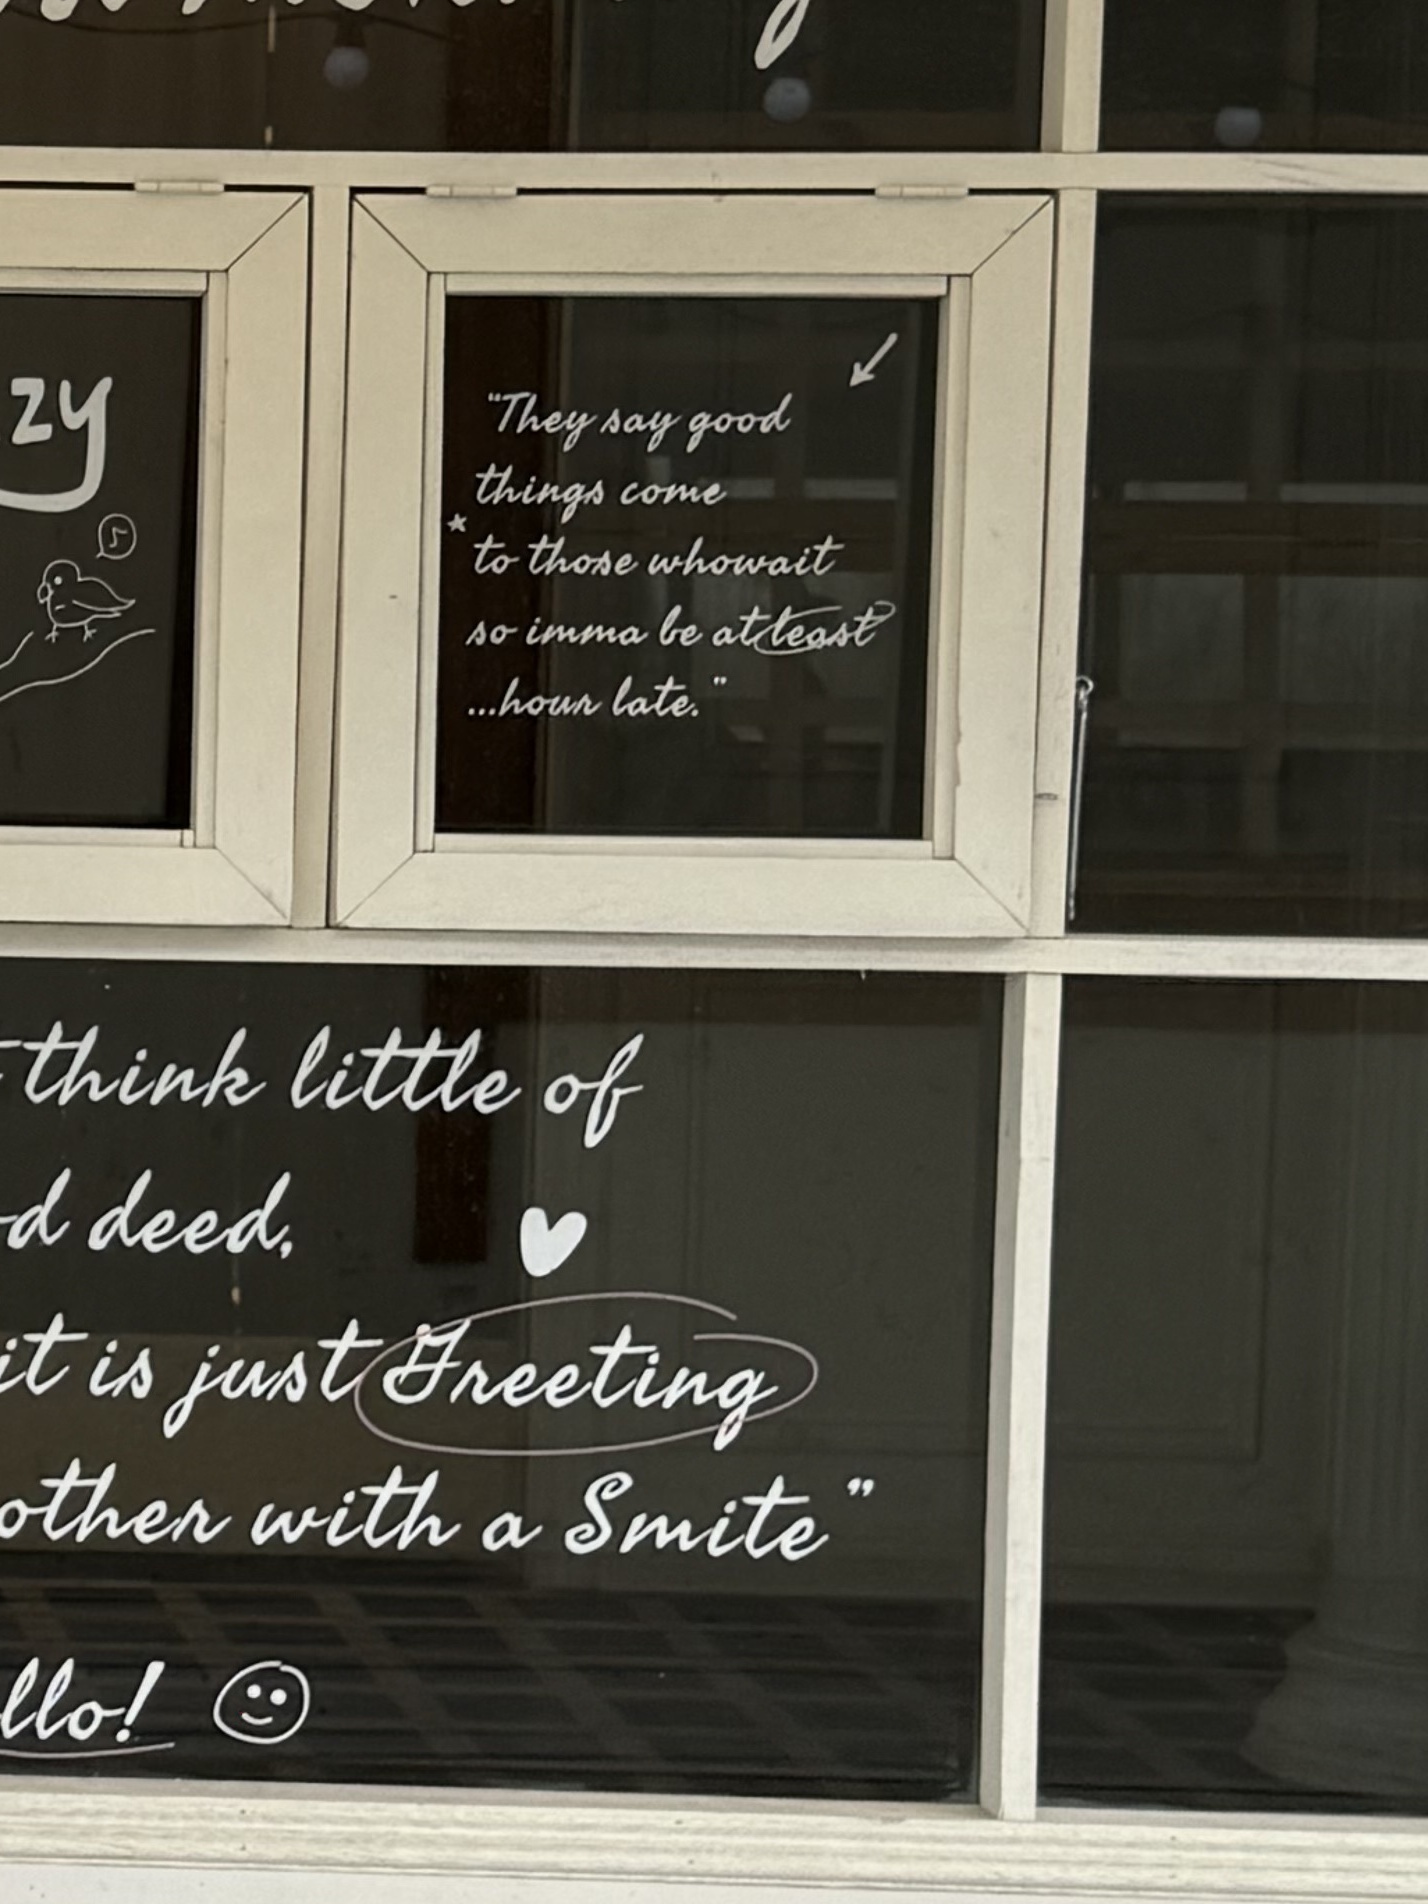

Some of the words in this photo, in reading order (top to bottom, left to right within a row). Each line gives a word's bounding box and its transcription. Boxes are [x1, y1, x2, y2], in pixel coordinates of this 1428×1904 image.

[599, 408, 681, 453] say
[686, 392, 793, 454] good
[474, 462, 605, 524] things
[619, 481, 727, 506] come
[473, 533, 520, 575] to
[526, 533, 640, 576] those
[464, 619, 519, 647] so
[525, 615, 649, 648] imma
[658, 604, 704, 648] be
[21, 1020, 268, 1108] think
[289, 1024, 523, 1115] little
[543, 1032, 646, 1150] of
[86, 1167, 293, 1260] deed,
[87, 1338, 155, 1399] is
[162, 1317, 385, 1439] just
[380, 1318, 781, 1453] Greeting
[249, 1464, 463, 1552] with
[480, 1511, 544, 1553] a
